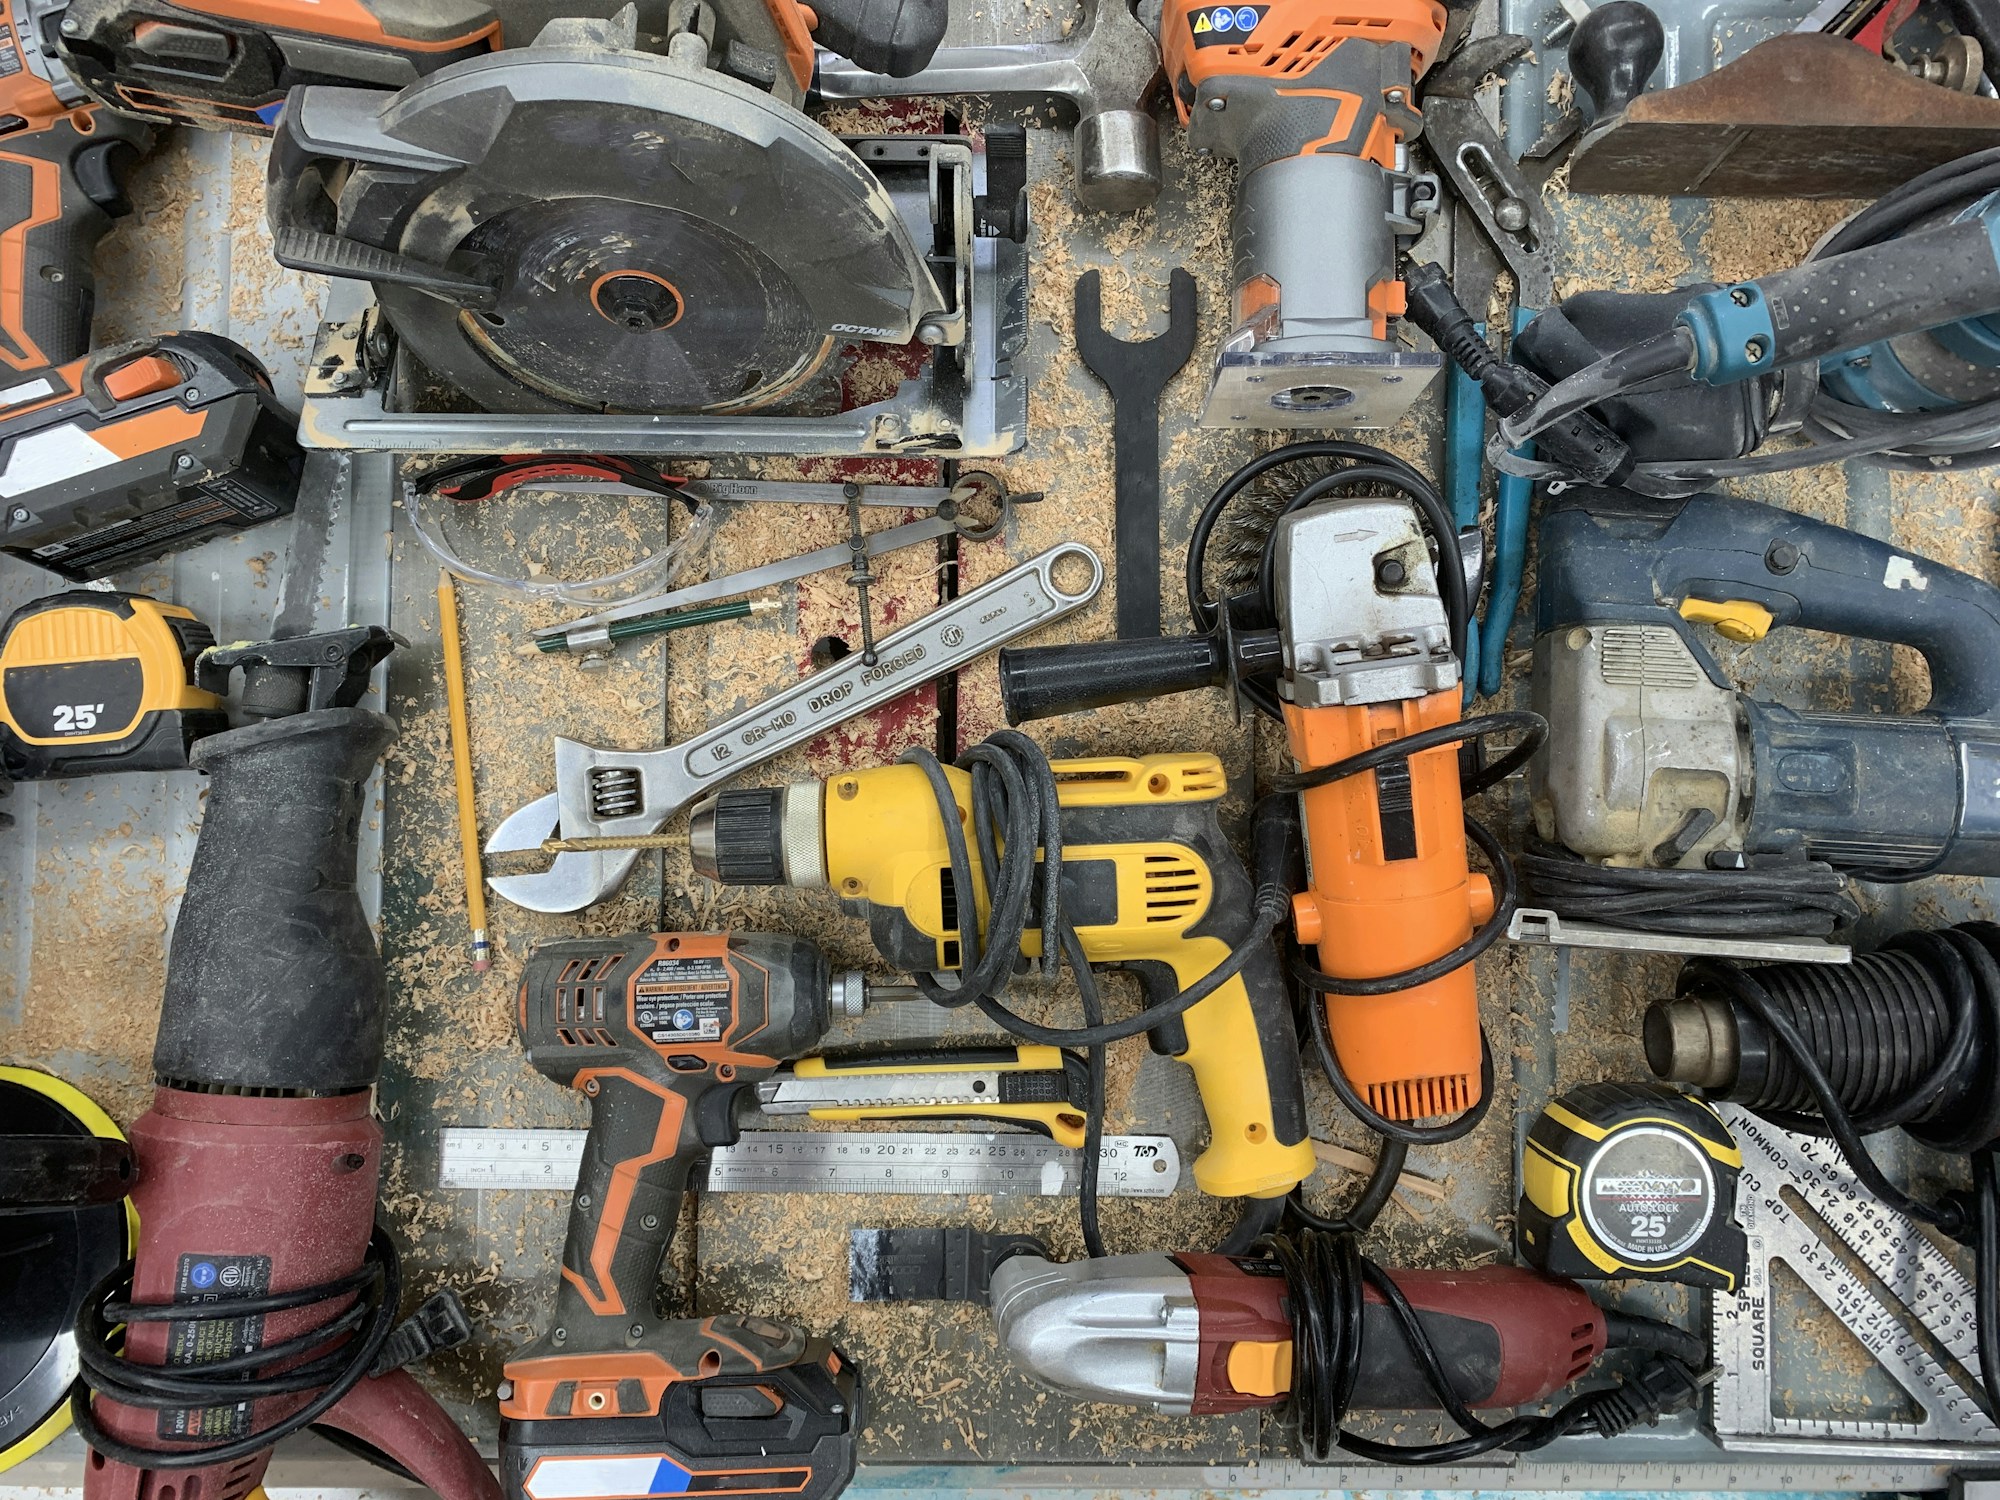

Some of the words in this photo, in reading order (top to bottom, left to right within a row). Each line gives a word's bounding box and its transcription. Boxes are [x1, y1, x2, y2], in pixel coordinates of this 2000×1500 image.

[830, 323, 902, 337] OCTANE
[710, 482, 758, 496] BigHorn
[711, 743, 731, 761] 12
[742, 710, 797, 746] CR-MO
[807, 681, 853, 714] DROP
[861, 644, 927, 687] FORGED
[52, 704, 104, 732] 25'
[542, 1142, 549, 1151] 5
[768, 1144, 783, 1154] 15
[860, 1147, 870, 1155] 19
[877, 1145, 895, 1155] 20
[969, 1148, 981, 1156] 24
[988, 1147, 1006, 1156] 25
[1100, 1148, 1118, 1158] 30
[1738, 1118, 1788, 1171] COMMON
[1801, 1142, 1819, 1161] 70
[489, 1164, 494, 1173] 1
[544, 1165, 551, 1174] 2
[715, 1168, 722, 1176] 5
[772, 1168, 778, 1176] 6
[829, 1168, 835, 1177] 7
[886, 1169, 892, 1177] 8
[942, 1170, 949, 1178] 9
[1000, 1170, 1014, 1179] 10
[1113, 1172, 1127, 1181] 12
[1819, 1163, 1838, 1182] 65
[1802, 1170, 1821, 1189] 30
[1820, 1188, 1840, 1207] 24
[1839, 1182, 1856, 1201] 60
[1619, 1204, 1679, 1212] AUTO-LOCK
[1765, 1199, 1790, 1224] TOP
[1856, 1201, 1875, 1220] 55
[1631, 1216, 1671, 1237] 25'
[1843, 1212, 1859, 1228] 18
[1874, 1220, 1892, 1238] 50
[1859, 1230, 1875, 1245] 15
[1627, 1243, 1645, 1252] MADE
[1655, 1243, 1668, 1252] USA
[1800, 1244, 1818, 1263] 30
[1890, 1237, 1908, 1255] 45
[1879, 1250, 1895, 1267] 12
[1908, 1255, 1926, 1273] 40
[1817, 1262, 1836, 1281] 24
[1896, 1268, 1911, 1284] 10
[1924, 1273, 1944, 1293] 35
[1837, 1284, 1853, 1300] 18
[1916, 1290, 1928, 1300] 8
[1850, 1298, 1866, 1313] 15
[1927, 1303, 1940, 1314] 7
[1943, 1292, 1962, 1312] 30
[1727, 1311, 1738, 1319] 2
[1866, 1313, 1882, 1330] 12
[1752, 1297, 1764, 1371] SQUARE
[1835, 1298, 1884, 1354] HIP-VAL
[1880, 1329, 1895, 1344] 10
[1953, 1330, 1965, 1341] 5
[1896, 1345, 1906, 1356] 8
[1903, 1356, 1915, 1366] 7
[1924, 1376, 1936, 1388] 5
[1936, 1386, 1946, 1397] 4
[1946, 1400, 1958, 1411] 3
[1960, 1412, 1971, 1424] 2
[1230, 1474, 1236, 1482] 0
[1780, 1476, 1792, 1484] 10
[1892, 1476, 1903, 1484] 12
